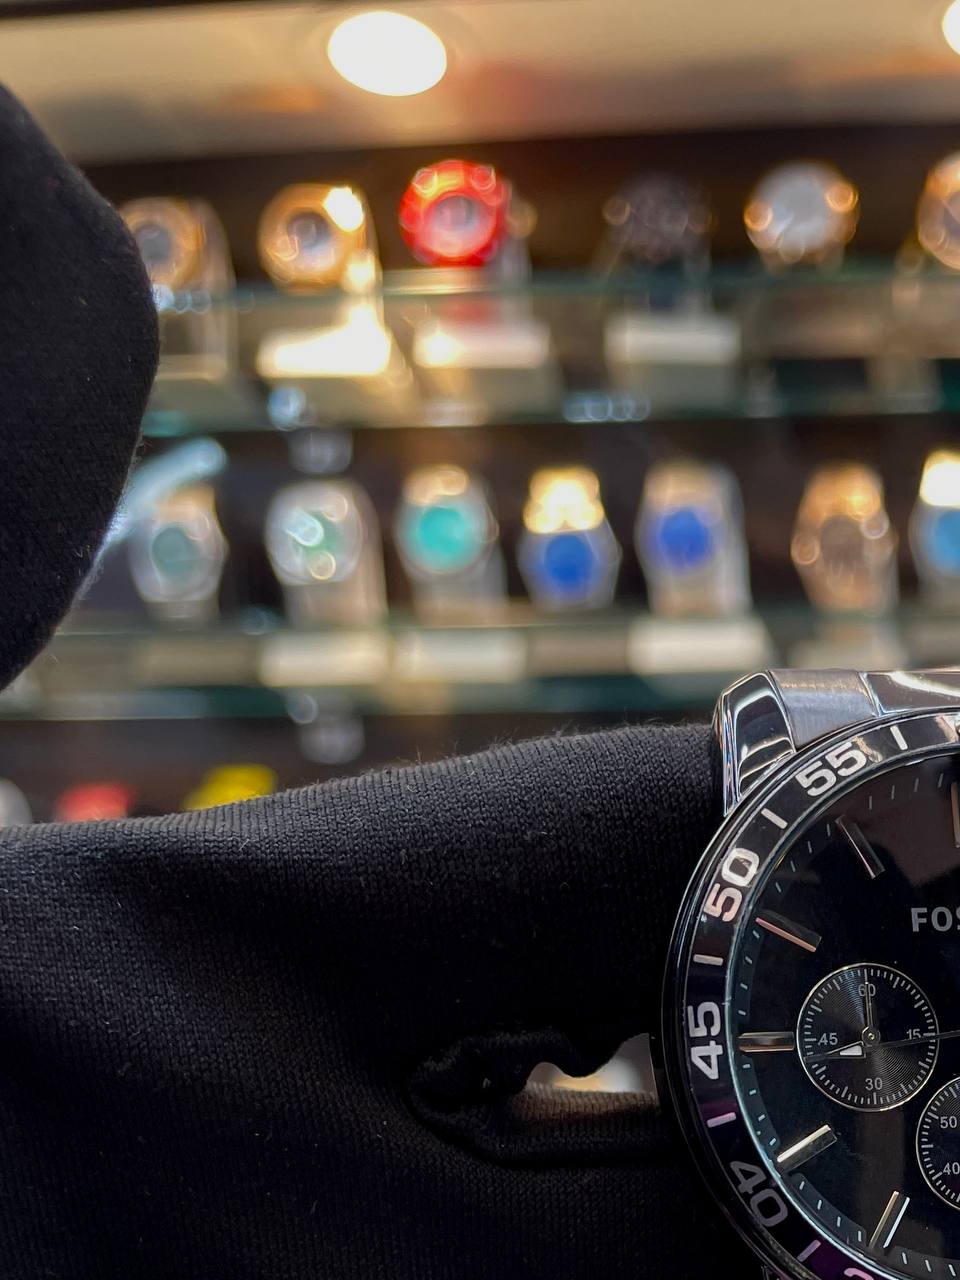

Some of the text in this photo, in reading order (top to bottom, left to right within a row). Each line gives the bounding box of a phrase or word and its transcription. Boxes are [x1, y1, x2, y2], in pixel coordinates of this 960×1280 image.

[795, 742, 867, 796] 55
[703, 847, 760, 923] 50
[689, 1001, 723, 1080] 45
[817, 1032, 839, 1046] 45
[906, 1029, 922, 1041] 15
[865, 1077, 883, 1091] 30
[940, 1115, 958, 1129] 50
[943, 1162, 960, 1175] 40
[729, 1160, 789, 1228] 40
